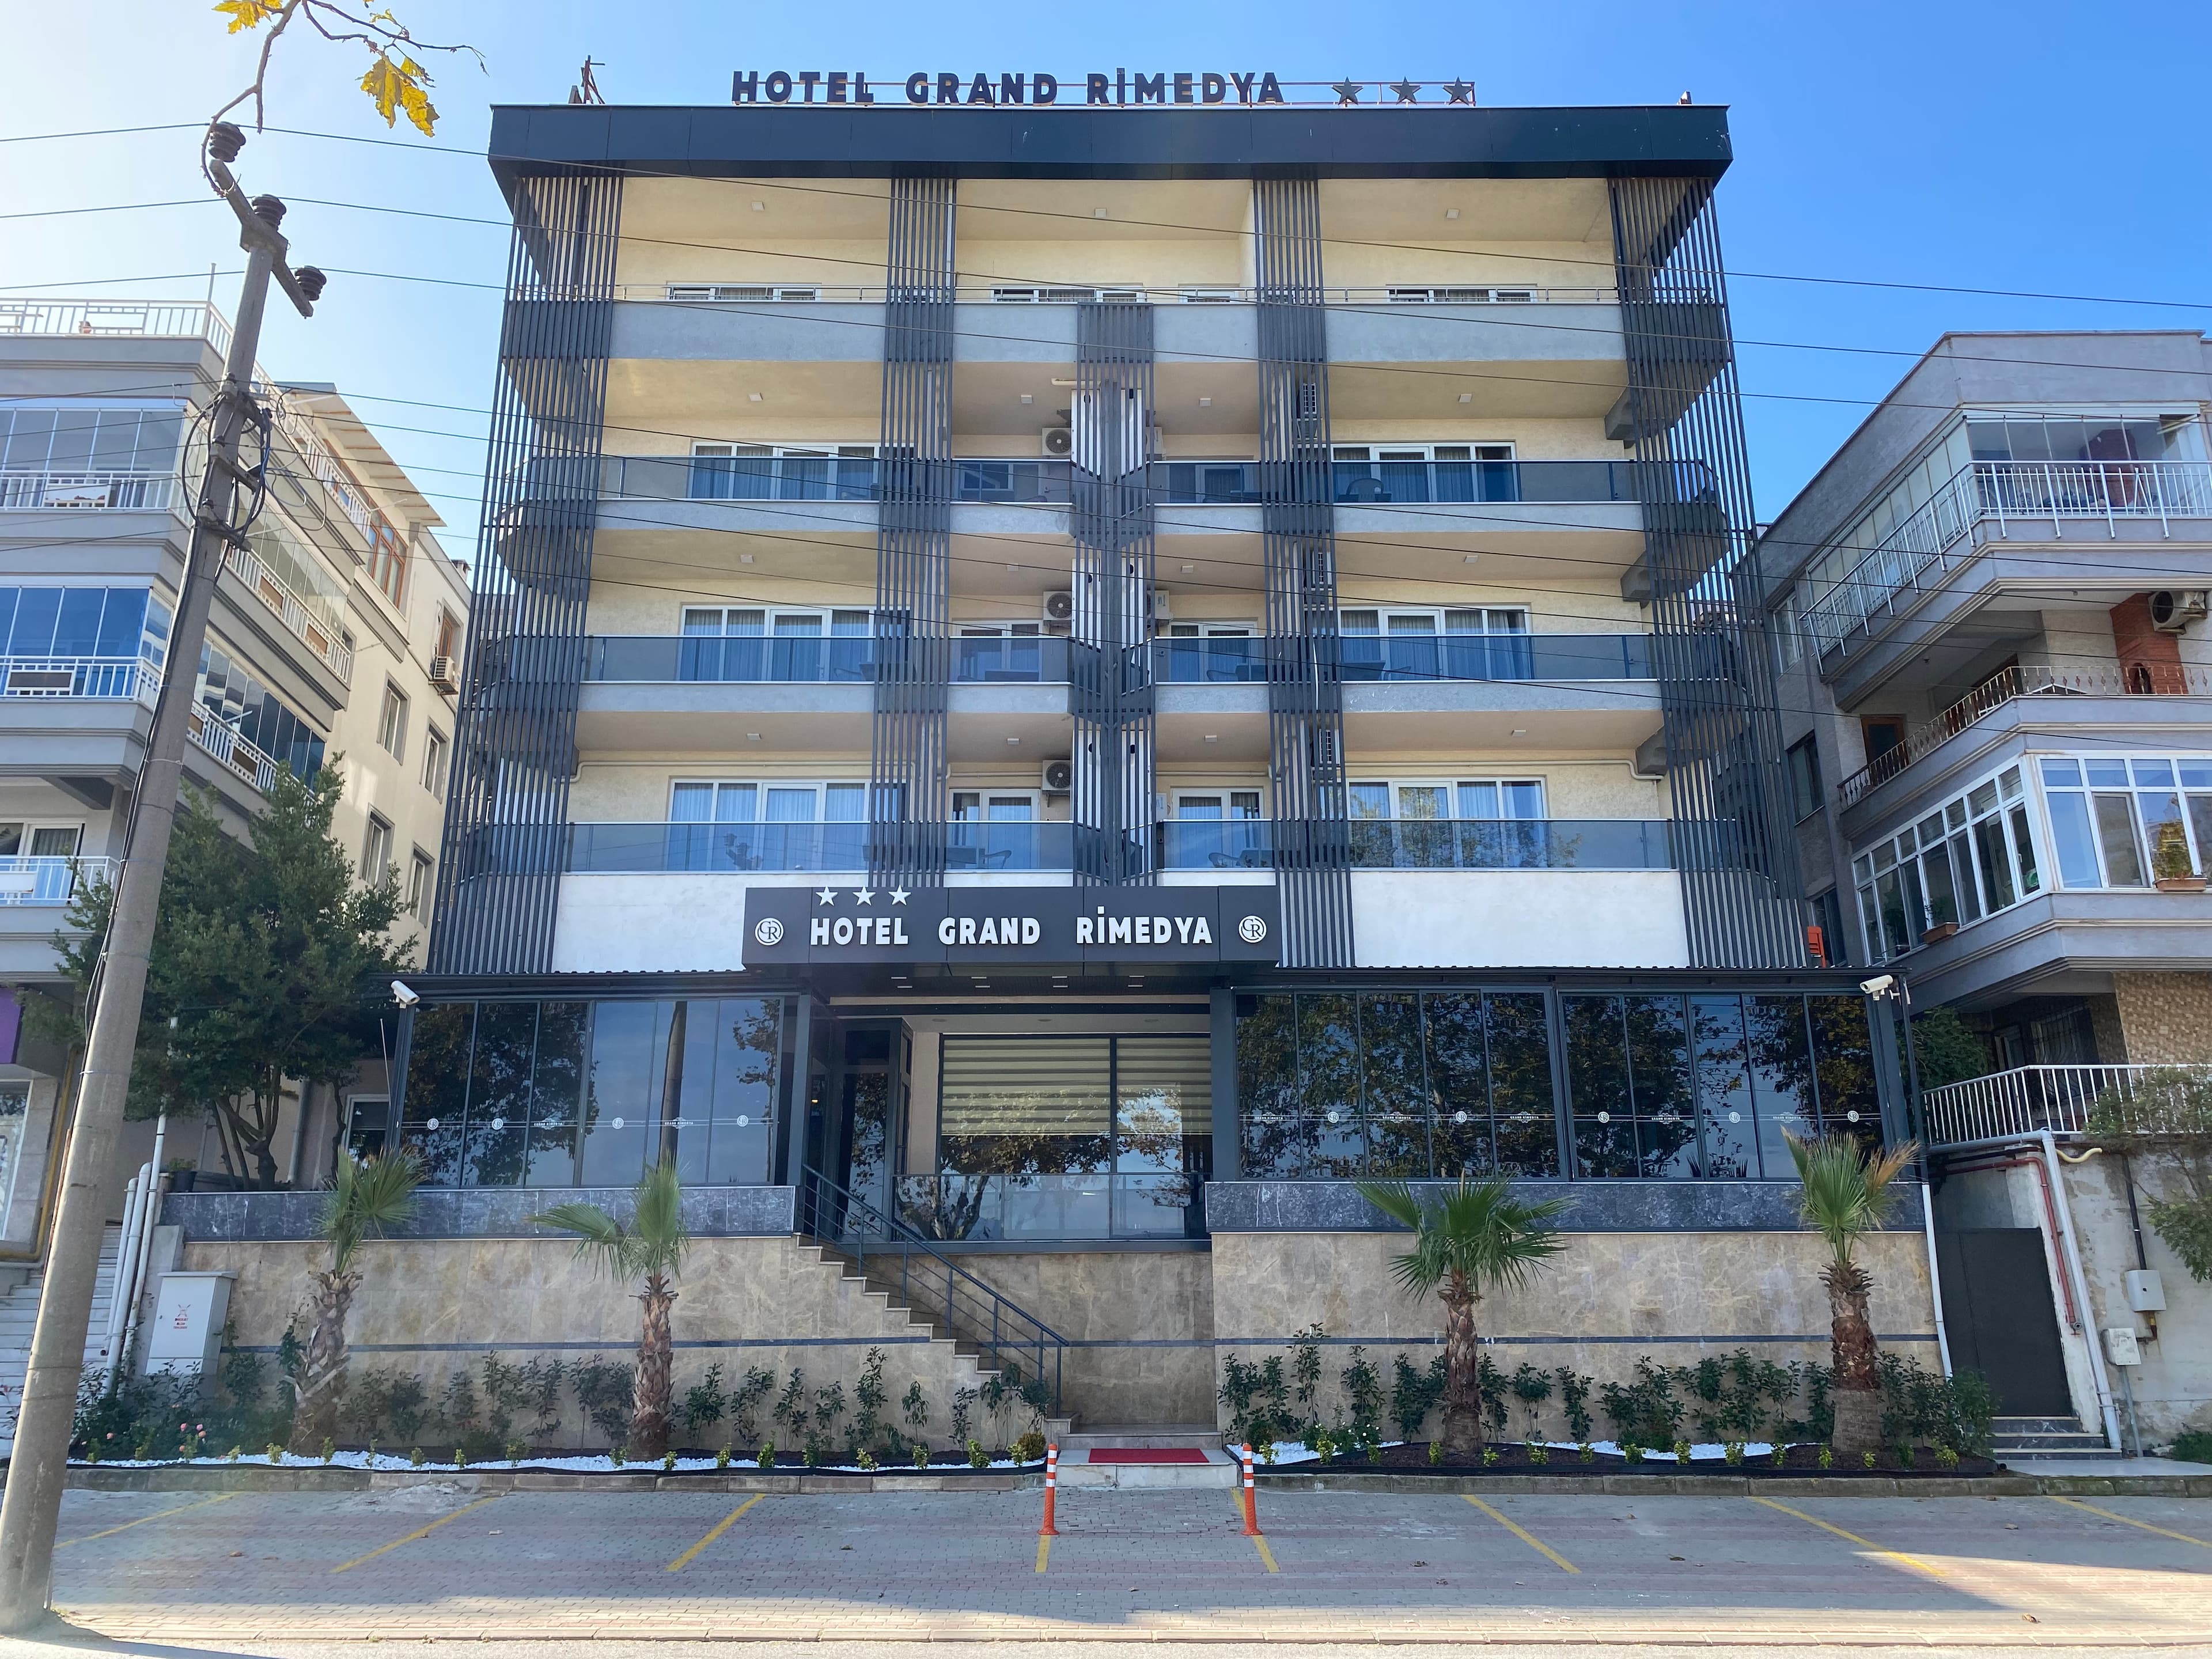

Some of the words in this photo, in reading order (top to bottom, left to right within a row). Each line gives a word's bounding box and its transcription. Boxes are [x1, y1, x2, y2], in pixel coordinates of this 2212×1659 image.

[732, 70, 874, 105] HOTEL
[905, 73, 1058, 107] GRAND
[1086, 67, 1285, 107] RİMEDYA
[810, 917, 908, 945] HOTEL
[938, 916, 1041, 945] GRAND
[1076, 906, 1213, 944] RİMEDYA
